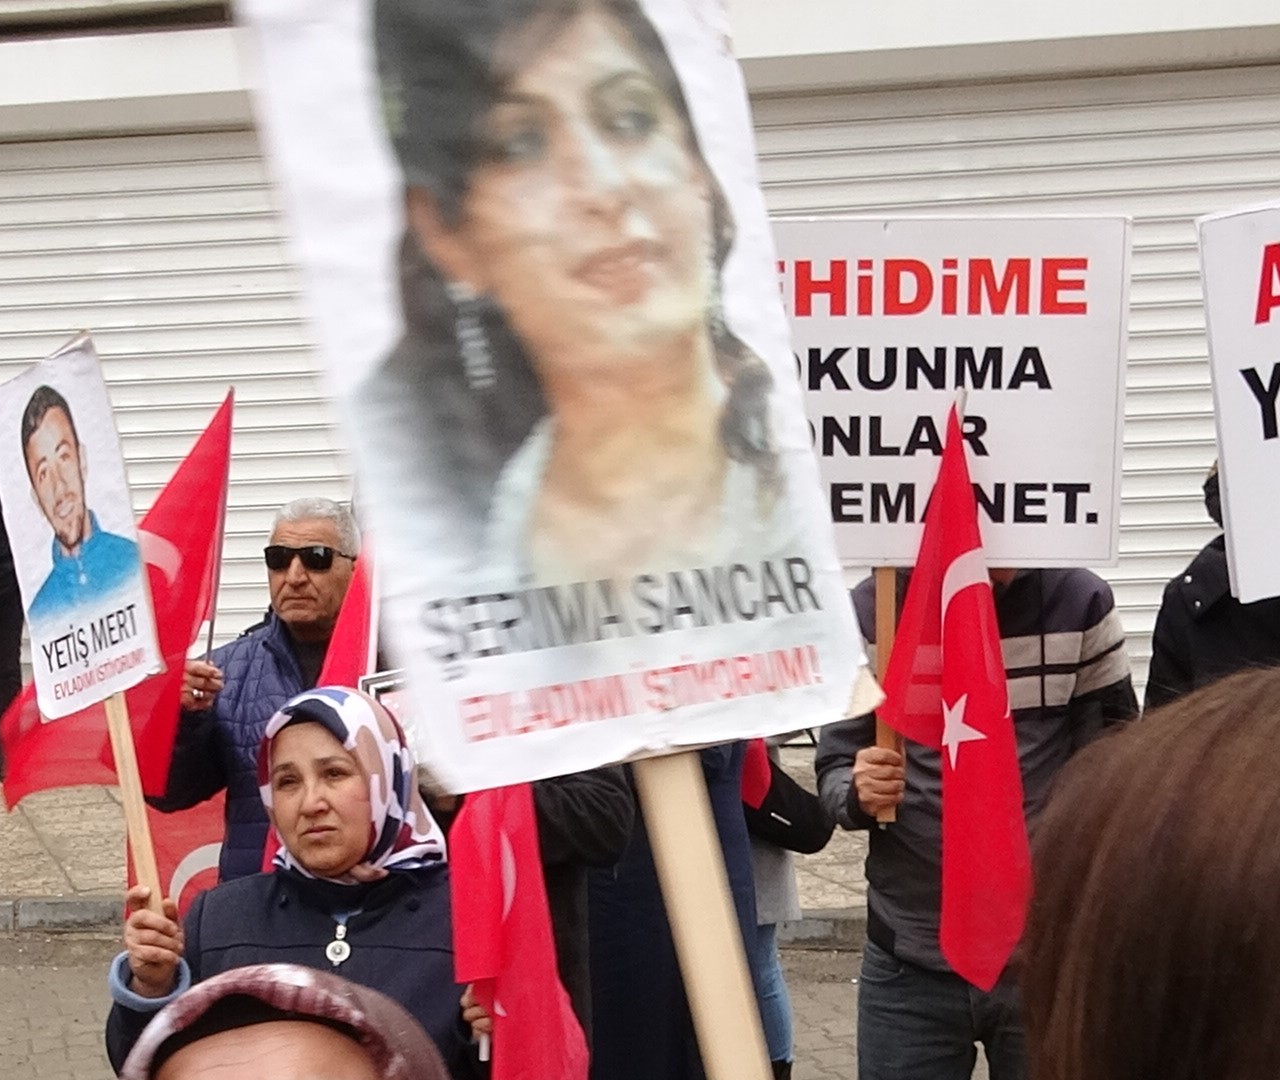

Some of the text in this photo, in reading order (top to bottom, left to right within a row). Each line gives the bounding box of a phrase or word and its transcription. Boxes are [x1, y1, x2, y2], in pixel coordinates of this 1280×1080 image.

[776, 257, 1089, 317] HiDiME
[795, 346, 1052, 391] KUNMA
[811, 415, 989, 457] NLAR
[831, 482, 1099, 524] EMNET.
[631, 557, 821, 635] SANCAR
[42, 603, 138, 673] YETİŞ MERT
